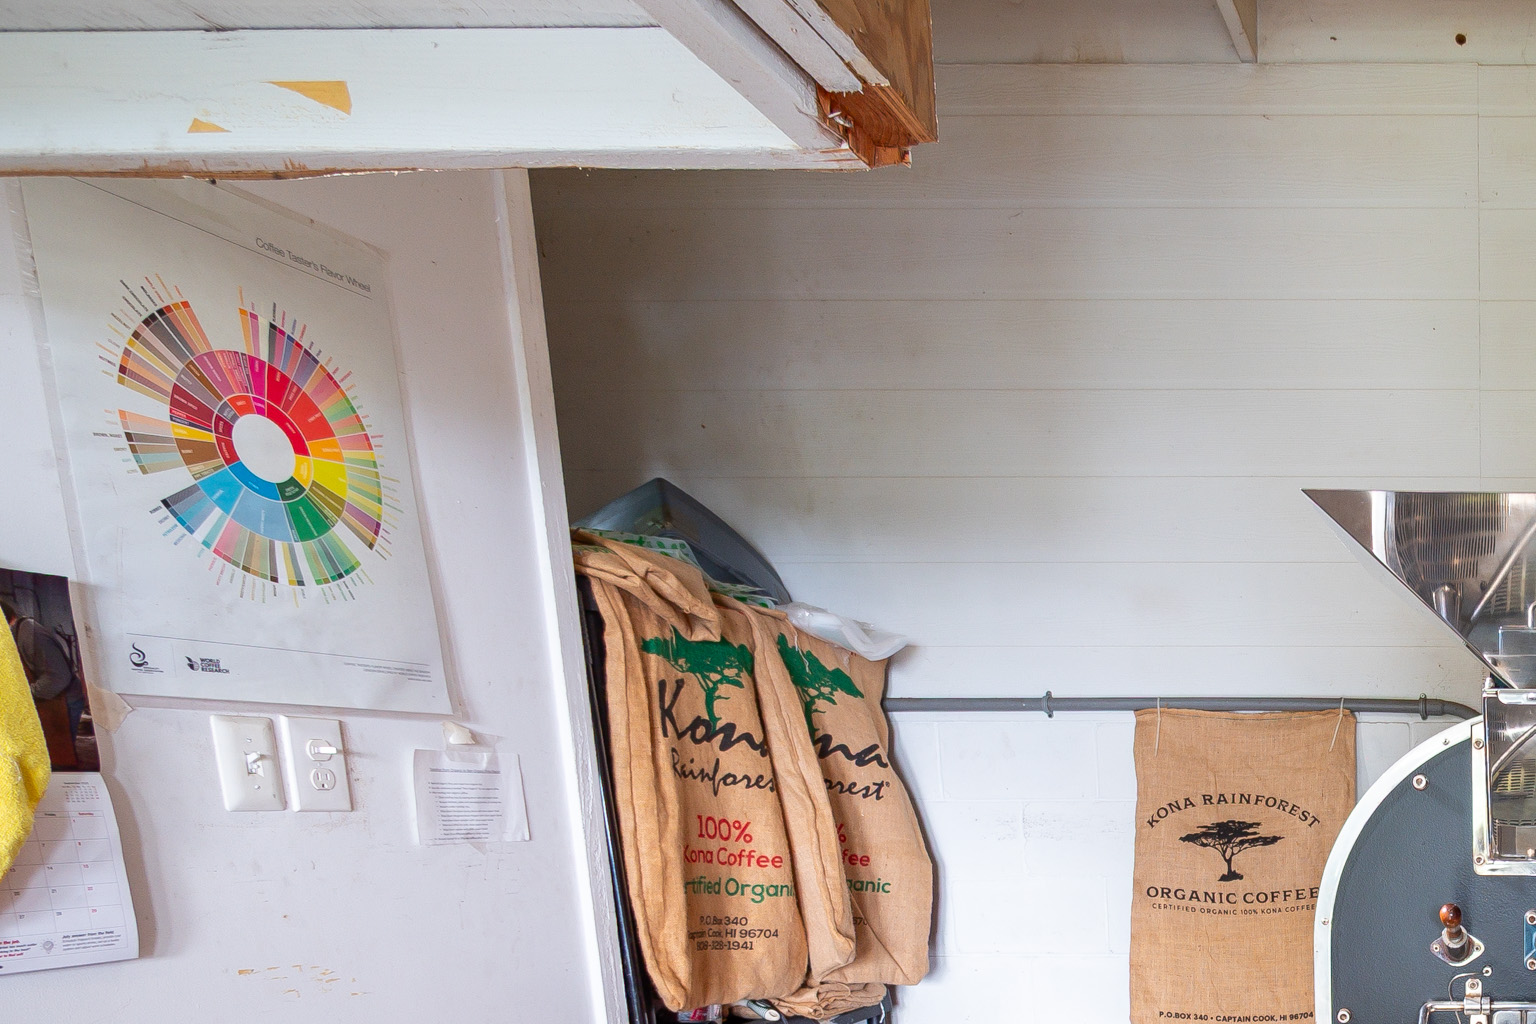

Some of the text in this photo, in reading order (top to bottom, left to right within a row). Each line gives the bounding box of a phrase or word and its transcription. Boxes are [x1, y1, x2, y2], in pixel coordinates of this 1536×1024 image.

[256, 237, 285, 258] Coffee
[286, 249, 319, 272] Taster's
[346, 275, 371, 293] Wheel
[658, 678, 769, 758] Kon
[1146, 793, 1320, 830] KONA RAINFOREST
[697, 814, 753, 844] 100%
[716, 847, 784, 868] Coffee
[724, 877, 795, 904] Organi
[1146, 886, 1320, 904] ORGANIC COFFEE
[1152, 902, 1196, 913] CERTIFIED
[1200, 907, 1238, 916] ORGANIC
[1261, 907, 1282, 915] KONA
[1284, 904, 1316, 913] COFFEE
[724, 916, 748, 926] 340
[725, 928, 736, 938] HI
[739, 928, 779, 938] 96704
[1216, 1015, 1250, 1023] CAPTAIN
[1288, 1011, 1314, 1020] 96704
